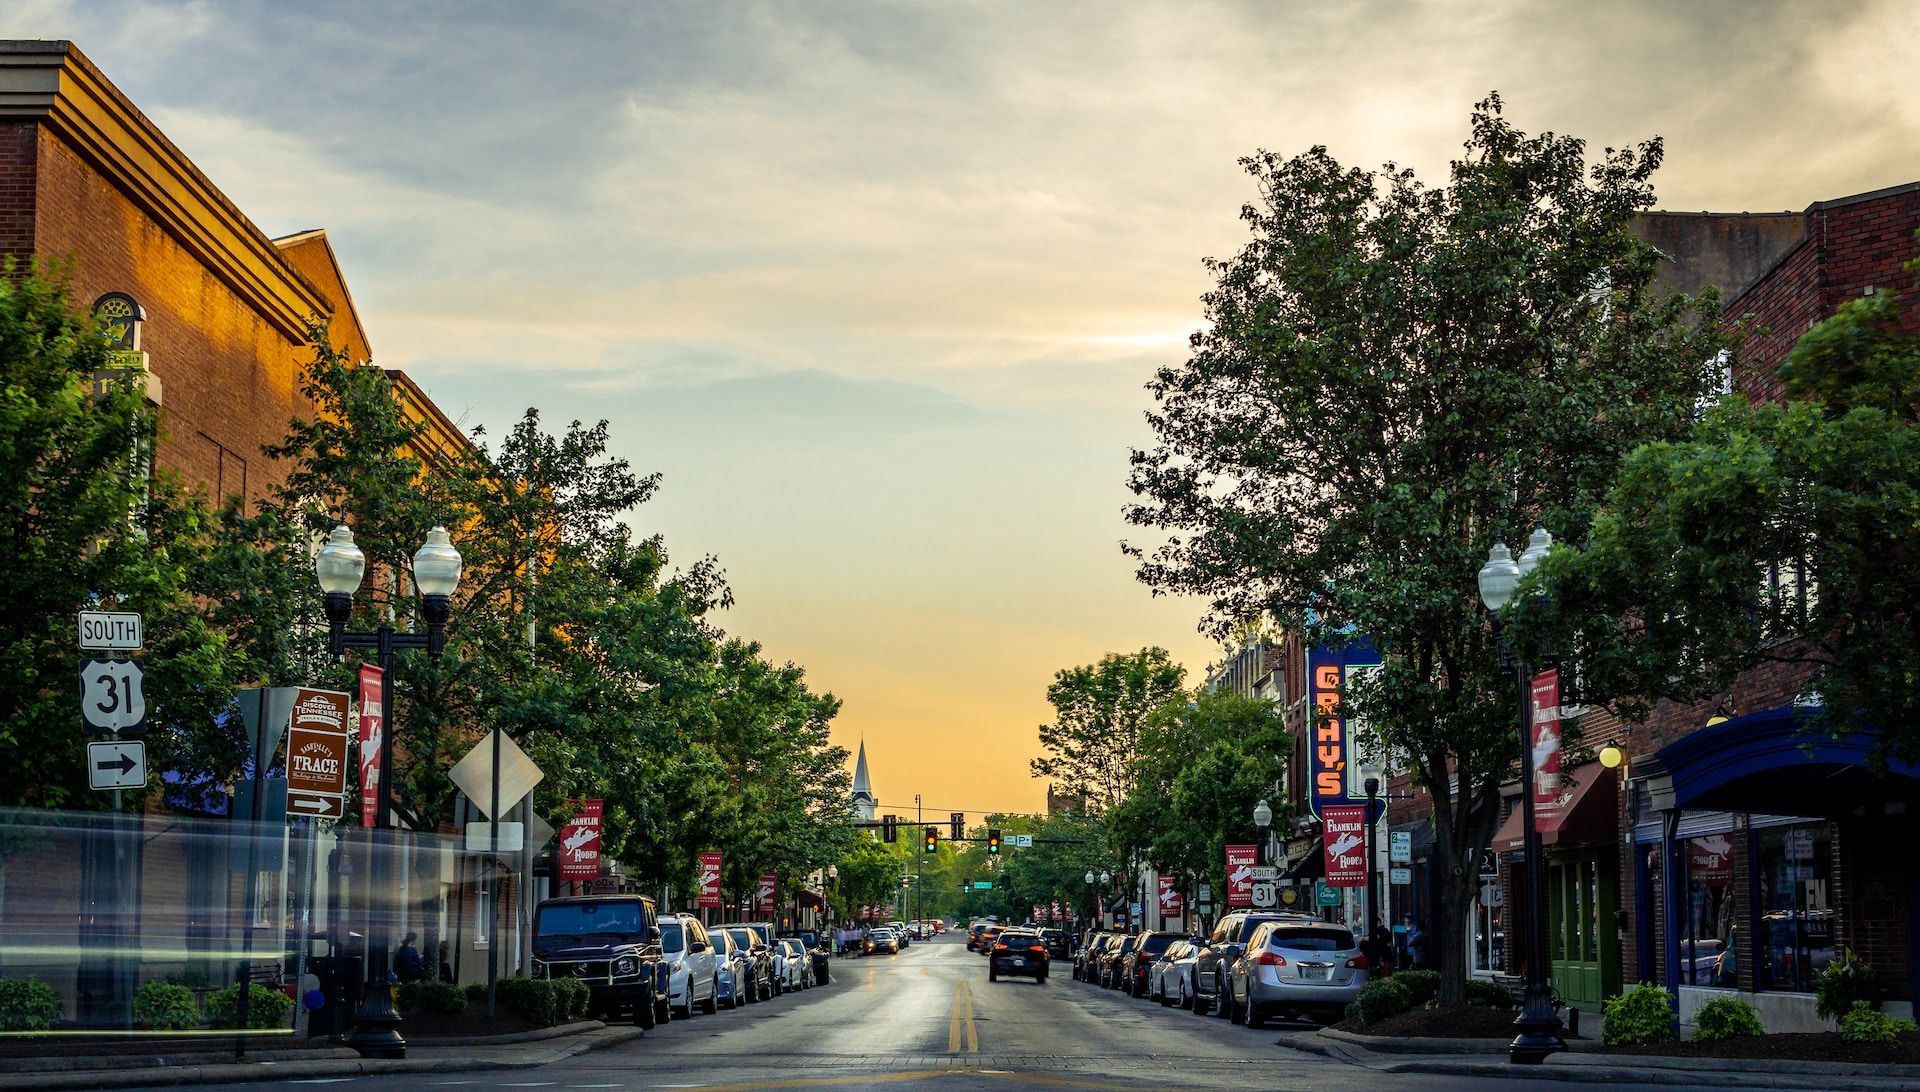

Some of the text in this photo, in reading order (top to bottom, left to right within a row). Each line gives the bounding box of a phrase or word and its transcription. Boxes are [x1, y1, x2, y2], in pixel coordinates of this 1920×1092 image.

[84, 620, 136, 640] SOUTH
[96, 674, 132, 714] 31
[295, 705, 343, 720] TENNESSEE
[302, 701, 337, 711] DISCOVER
[1316, 665, 1345, 795] GRAY'S
[293, 755, 339, 775] TRACE
[570, 817, 599, 826] RANKLIN
[1327, 819, 1362, 833] FRANKLIN
[574, 848, 598, 863] RODEO
[1229, 854, 1255, 866] FRANKLIN
[1339, 854, 1363, 869] RODEO
[1252, 868, 1276, 877] SOUTH
[1256, 887, 1271, 902] 31
